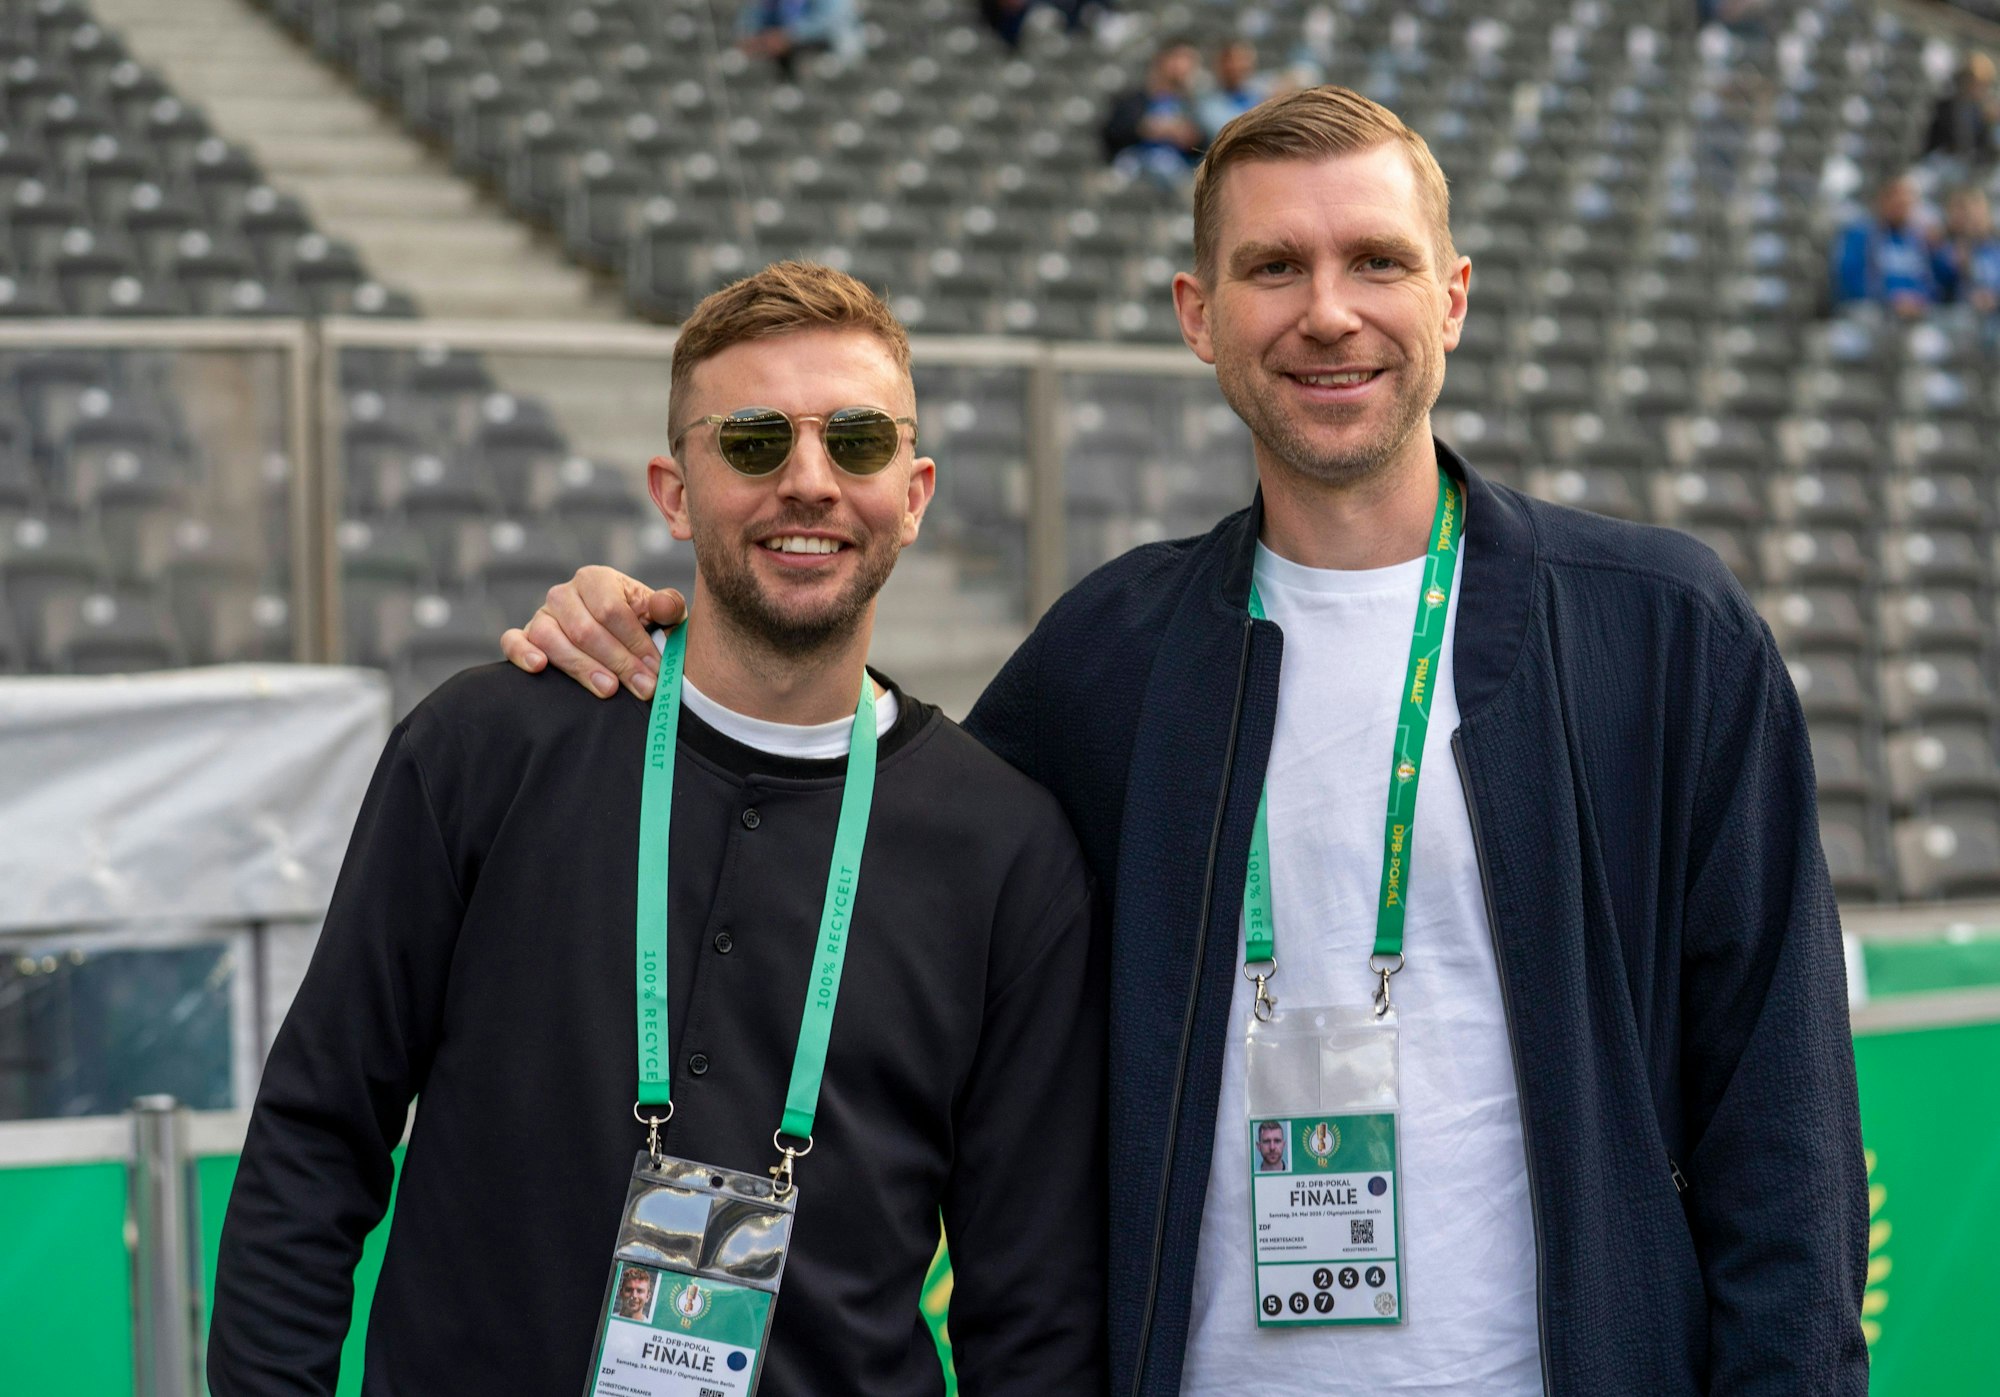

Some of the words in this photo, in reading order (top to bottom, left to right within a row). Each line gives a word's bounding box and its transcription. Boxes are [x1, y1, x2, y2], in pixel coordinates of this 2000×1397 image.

[662, 649, 678, 688] 100%
[1410, 658, 1429, 704] FINALE
[652, 693, 671, 770] RECYCELT
[1248, 850, 1261, 899] 100%
[1386, 824, 1405, 908] DFB-POKAL
[817, 962, 836, 1010] 100%
[827, 866, 852, 954] RECYCELT
[644, 951, 657, 1000] 100%
[644, 1008, 658, 1081] RECYCE
[1290, 1188, 1358, 1207] FINALE
[1309, 1179, 1351, 1188] DFB-POKAL
[1318, 1271, 1328, 1287] 2
[1344, 1270, 1354, 1286] 3
[1370, 1269, 1381, 1284] 4
[1267, 1297, 1277, 1312] 5
[1294, 1296, 1304, 1311] 6
[1318, 1295, 1329, 1310] 7
[641, 1342, 716, 1373] FINALE
[665, 1337, 711, 1354] DFB-POKAL
[598, 1380, 630, 1392] CHRISTOPH
[630, 1388, 652, 1397] KRAMER
[601, 1367, 616, 1375] ZDF
